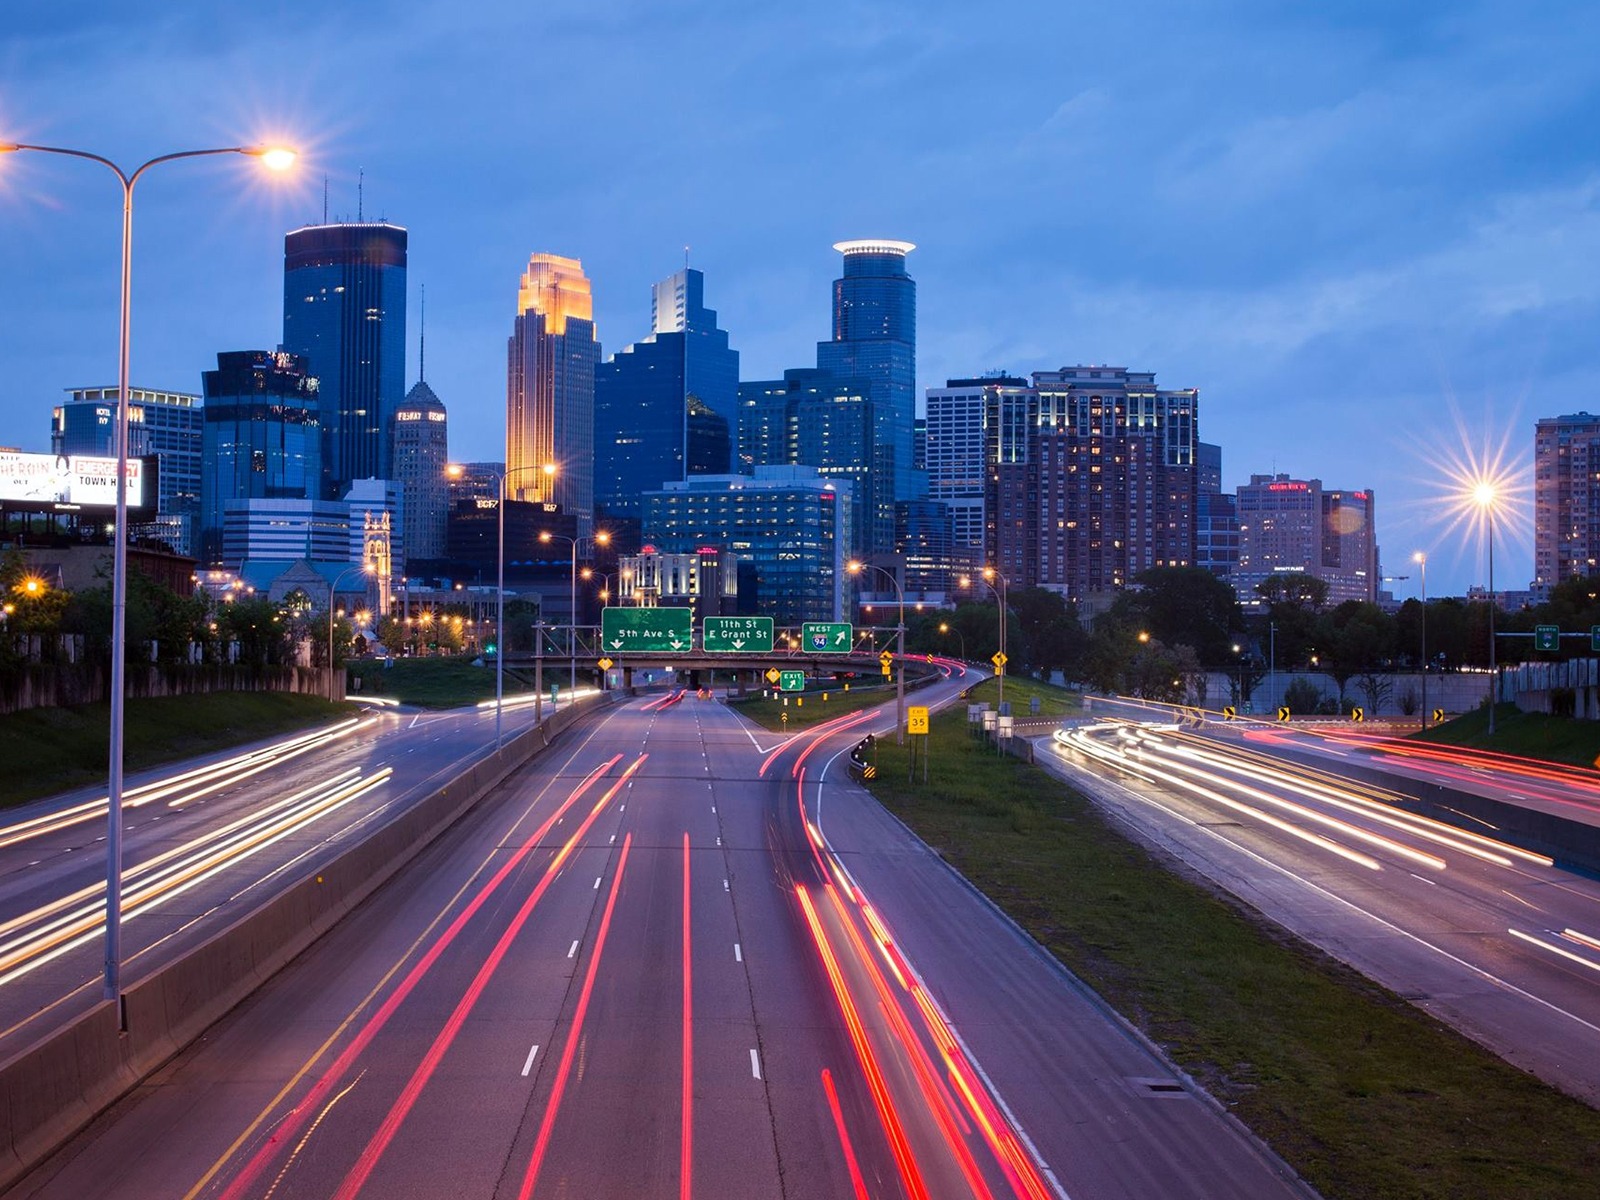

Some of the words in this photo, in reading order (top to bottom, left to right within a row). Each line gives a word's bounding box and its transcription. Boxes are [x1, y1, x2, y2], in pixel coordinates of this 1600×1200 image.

[79, 462, 137, 477] EMERGECY
[80, 476, 107, 486] TOWN
[110, 478, 133, 488] HL
[719, 620, 741, 629] 11th
[746, 620, 757, 629] St
[619, 629, 638, 638] 5th
[643, 629, 663, 638] Ave
[668, 629, 675, 638] S
[709, 630, 716, 639] E
[721, 630, 751, 639] Grant
[756, 630, 768, 639] St
[814, 637, 825, 646] 94
[912, 718, 925, 727] 35
